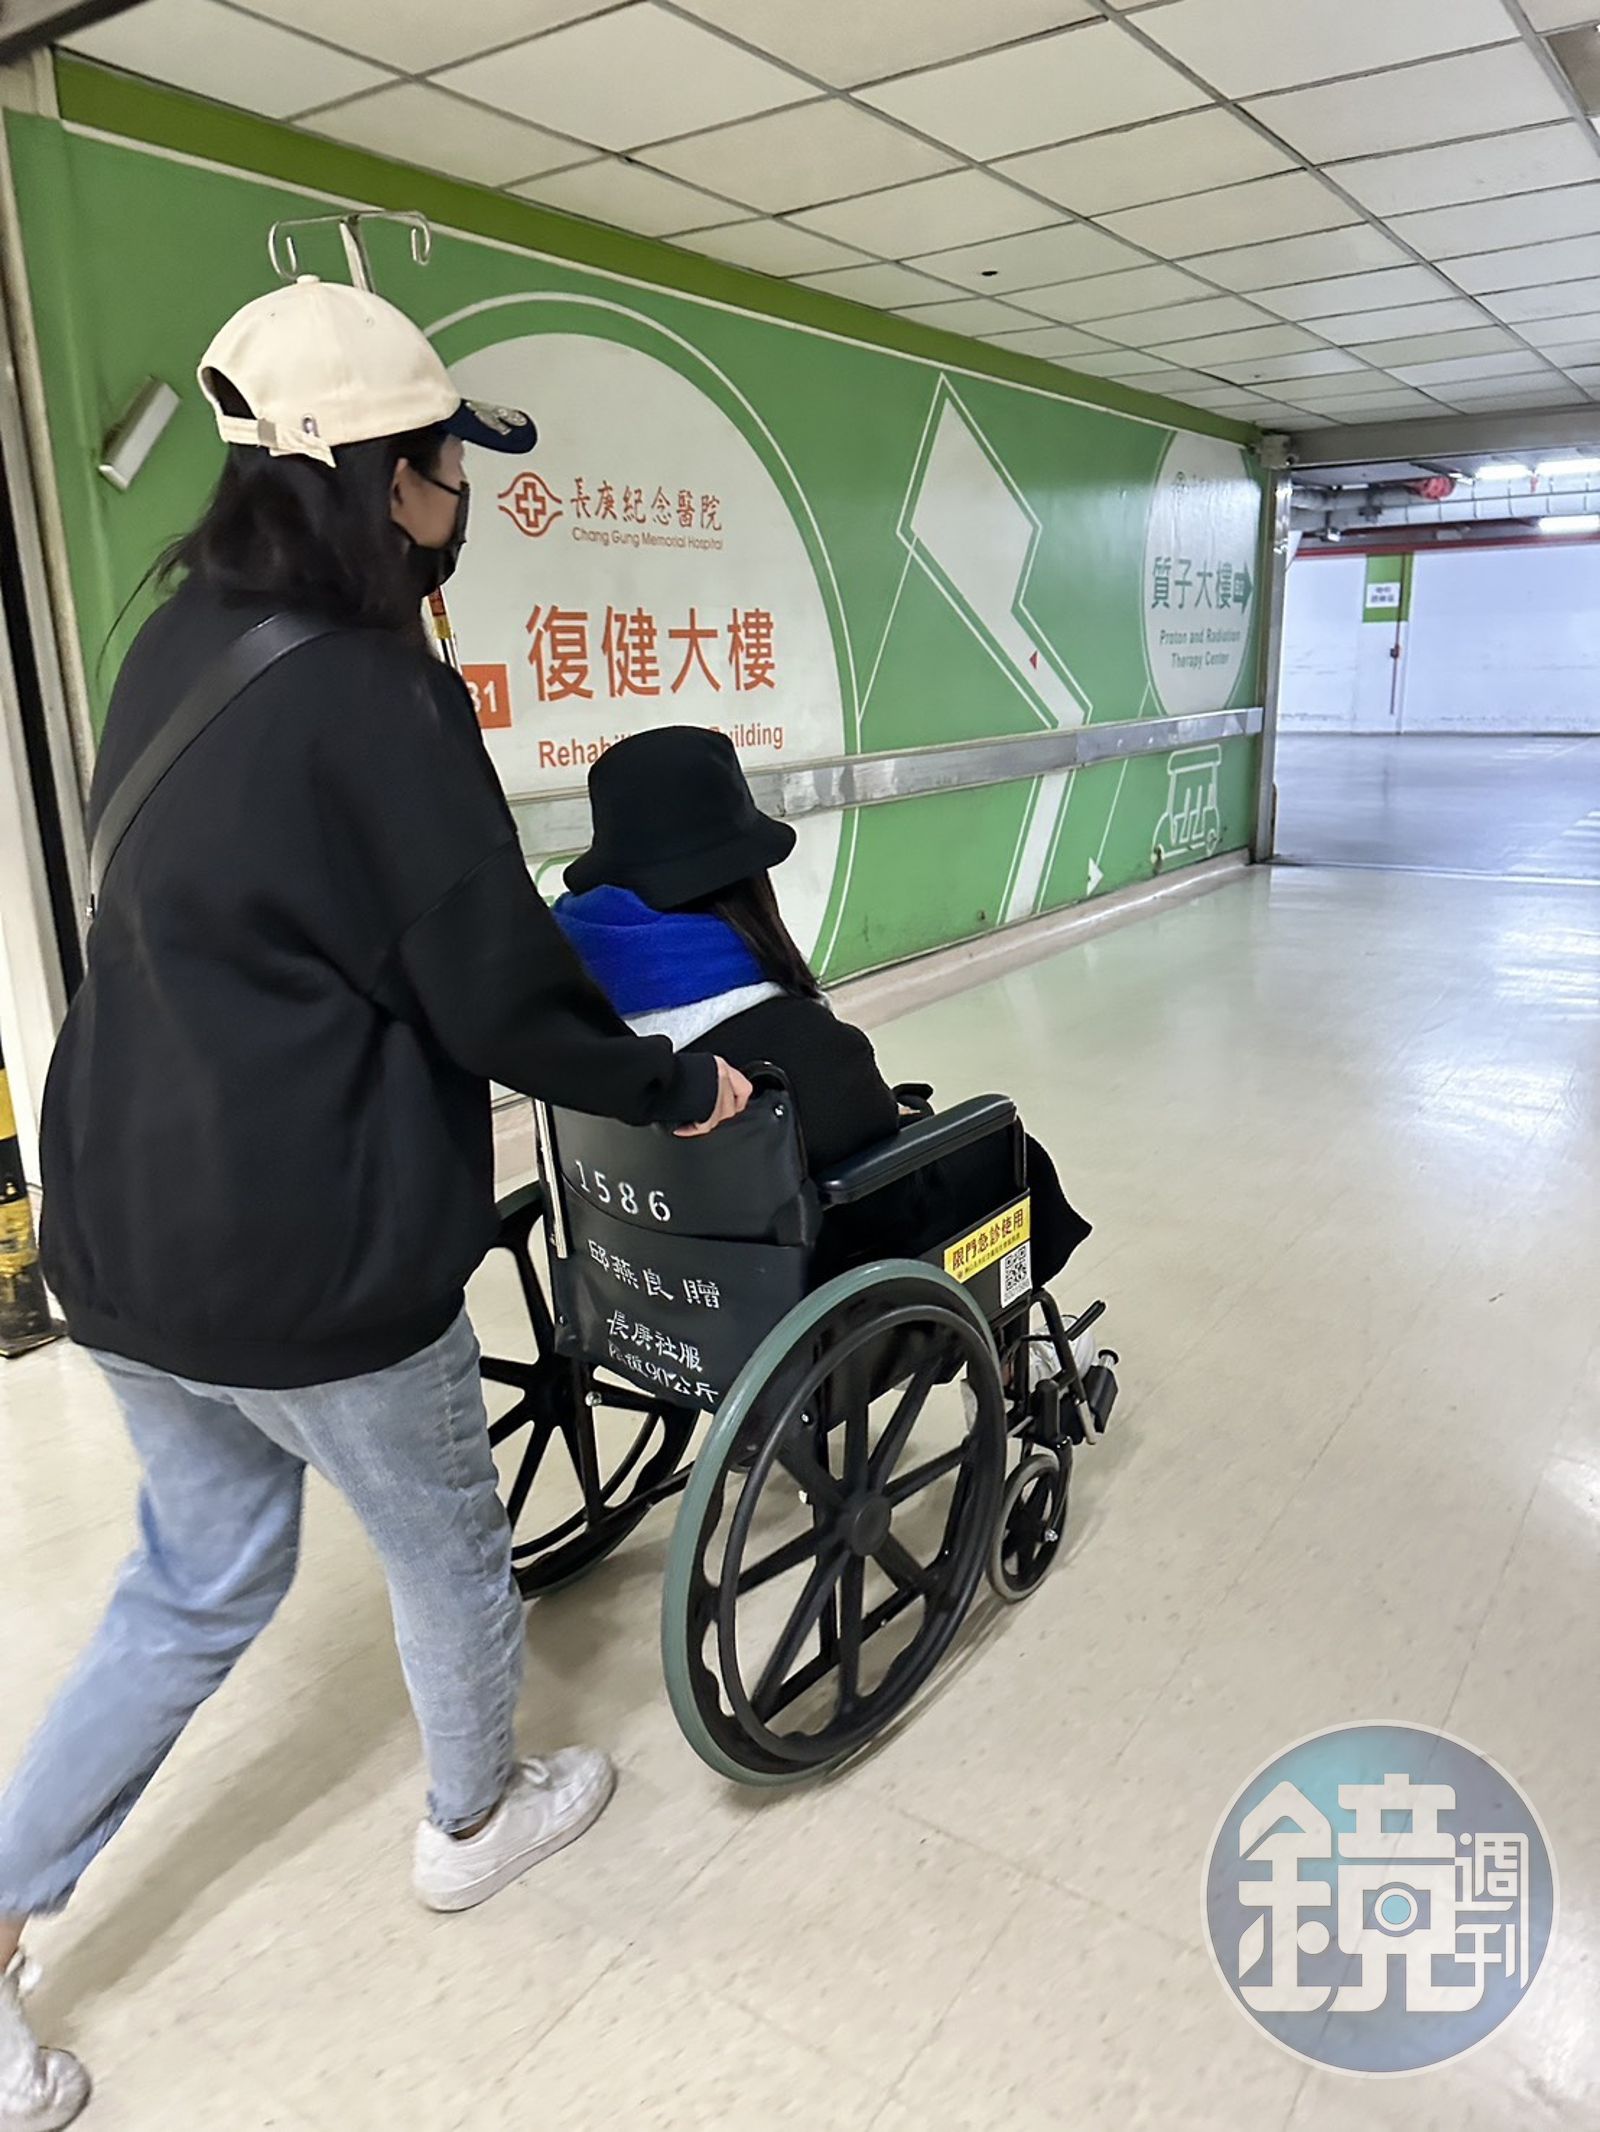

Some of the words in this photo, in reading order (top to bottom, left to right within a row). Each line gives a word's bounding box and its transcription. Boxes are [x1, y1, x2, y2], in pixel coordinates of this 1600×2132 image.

[570, 476, 722, 531] 長庚紀念醫院
[572, 526, 610, 546] Chang
[611, 530, 639, 547] Gung
[641, 532, 686, 550] Memorial
[688, 536, 724, 551] Hospital
[1151, 556, 1233, 610] 質子大樓
[525, 604, 777, 701] 復健大樓
[1159, 629, 1188, 646] Proton
[1189, 628, 1205, 644] and
[1206, 627, 1242, 643] Radiation
[1171, 652, 1202, 671] Therapy
[1205, 650, 1231, 667] Center
[574, 1159, 672, 1223] 1586
